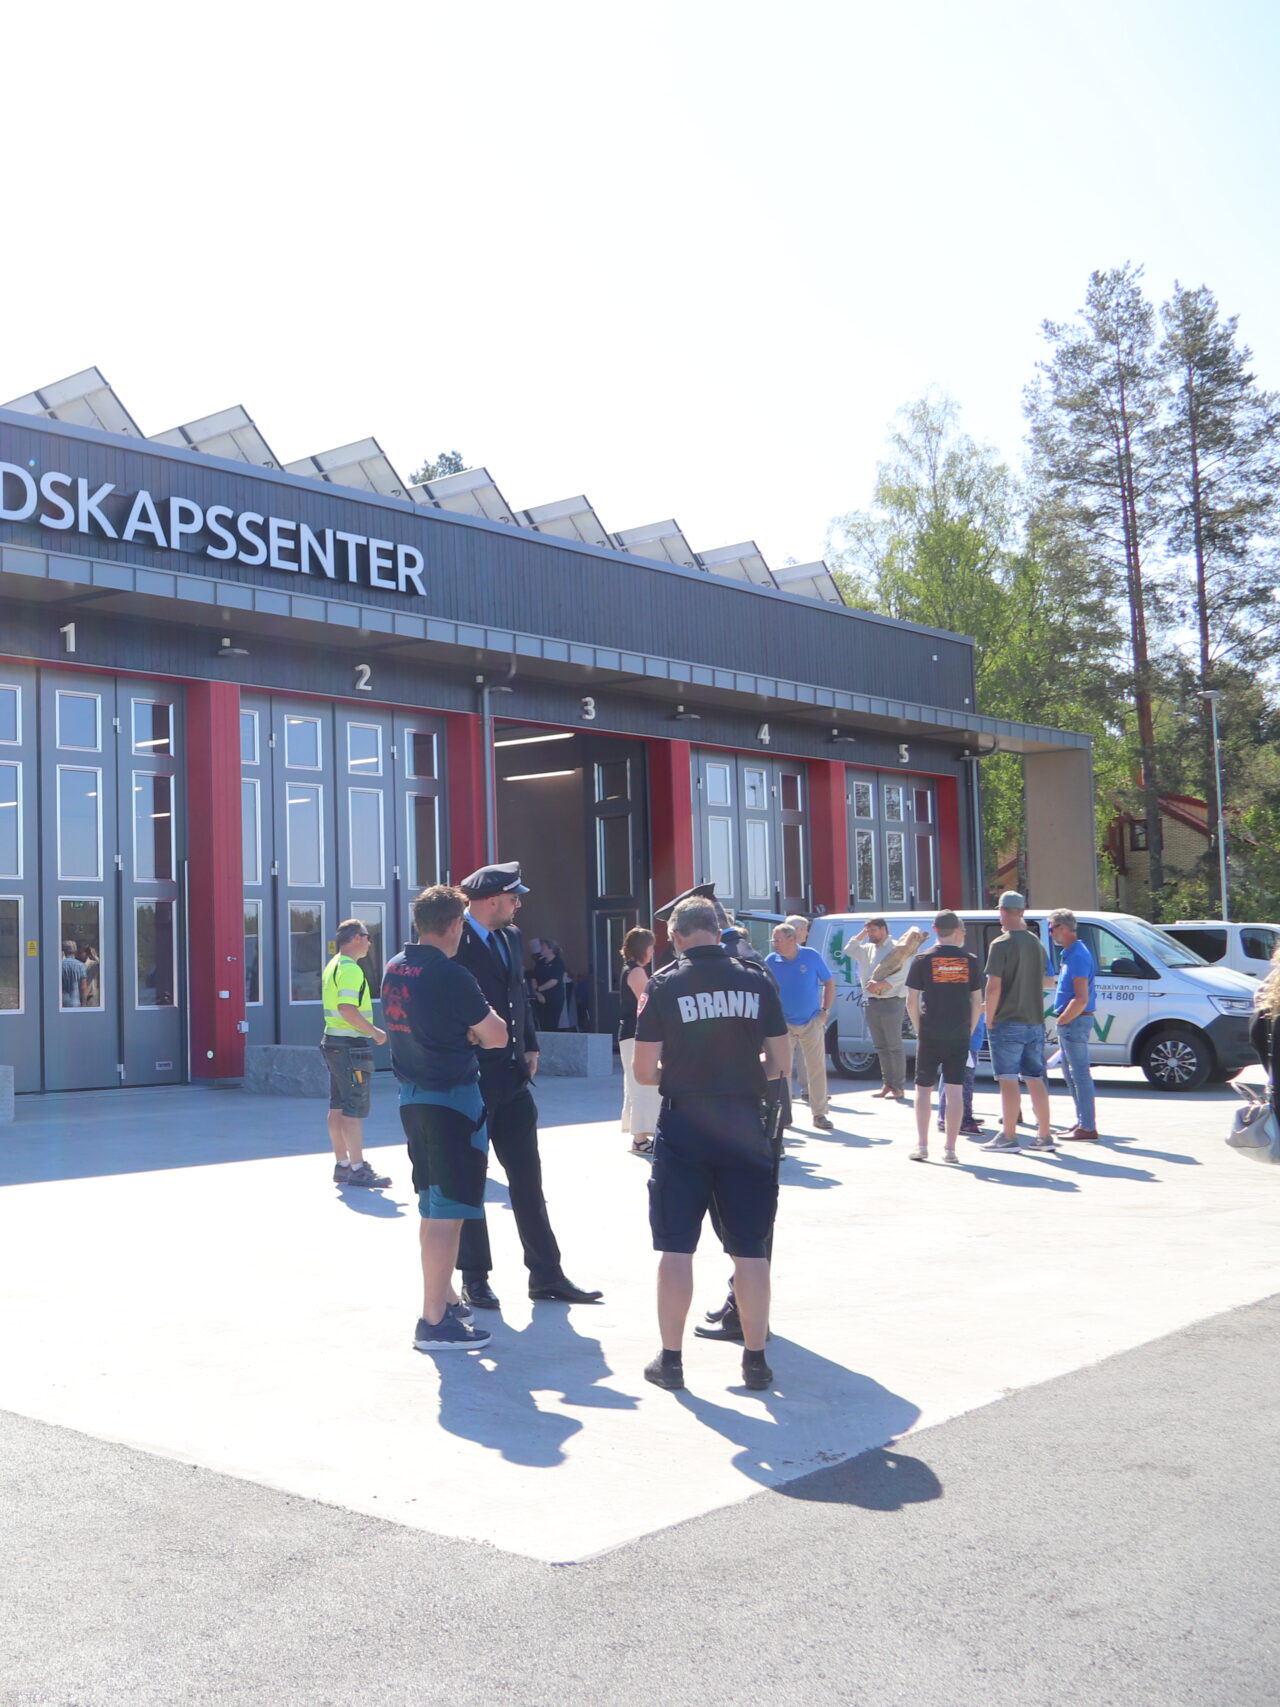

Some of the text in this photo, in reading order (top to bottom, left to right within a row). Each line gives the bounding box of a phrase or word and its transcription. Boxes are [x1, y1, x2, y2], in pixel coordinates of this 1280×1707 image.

[60, 622, 76, 652] 1
[354, 663, 372, 690] 2
[581, 696, 596, 720] 3
[757, 723, 771, 745] 4
[898, 744, 910, 763] 5
[677, 990, 760, 1023] BRANN
[1101, 992, 1135, 1001] 14 800
